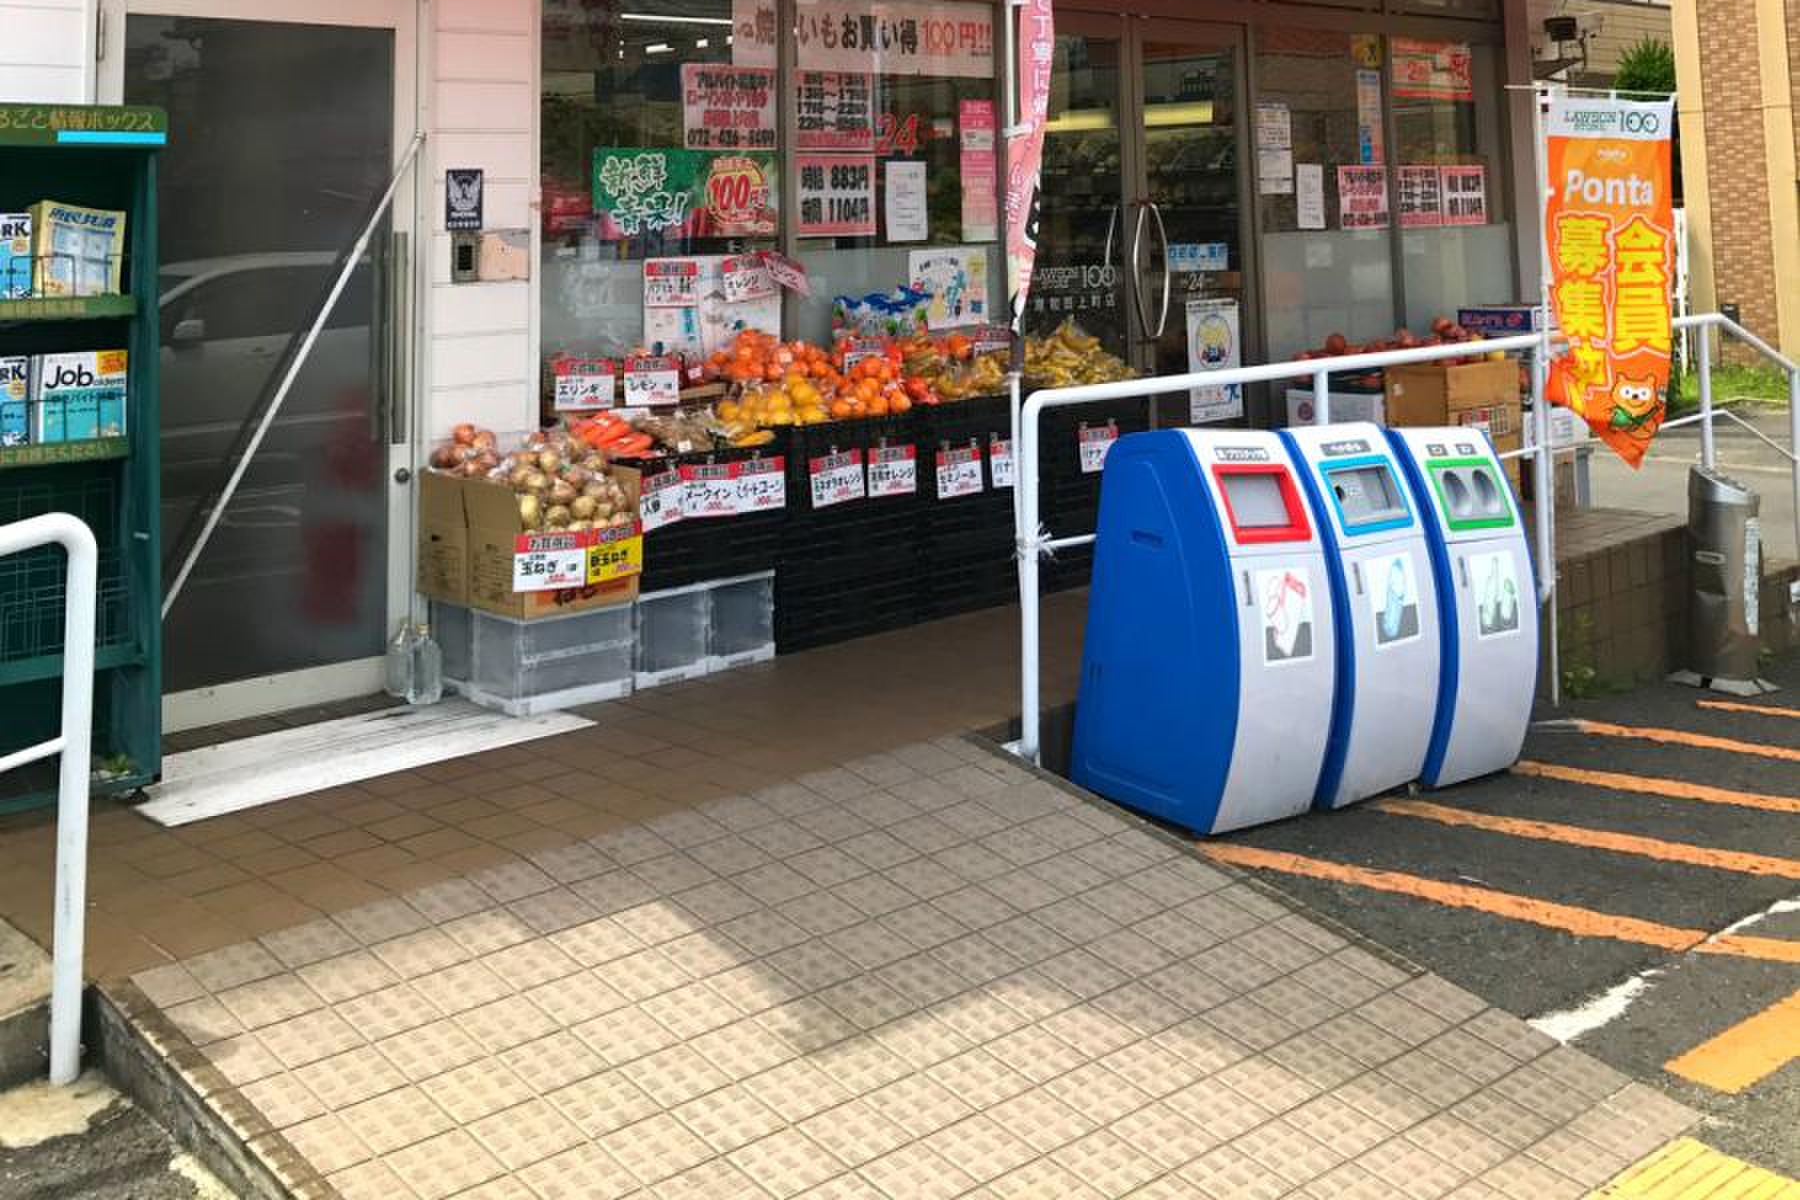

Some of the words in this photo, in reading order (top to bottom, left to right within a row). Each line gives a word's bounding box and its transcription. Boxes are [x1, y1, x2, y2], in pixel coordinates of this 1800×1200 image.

[1564, 169, 1654, 205] Ponta
[1614, 216, 1669, 352] 会員
[45, 363, 94, 388] Job
[520, 560, 559, 576] 玉ねぎ
